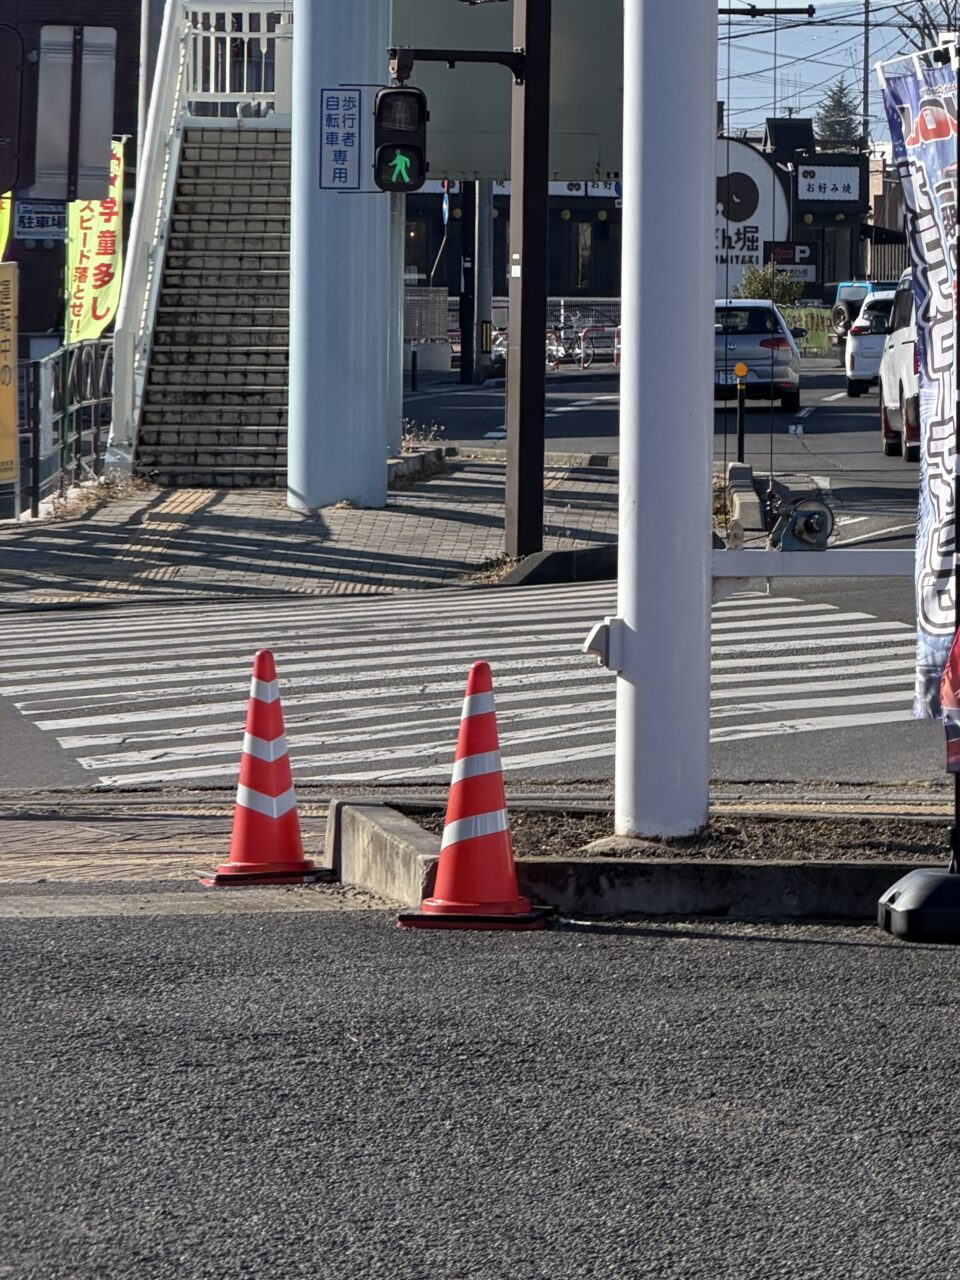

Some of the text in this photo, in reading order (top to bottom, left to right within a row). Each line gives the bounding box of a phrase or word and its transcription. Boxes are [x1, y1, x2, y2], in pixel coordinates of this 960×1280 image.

[325, 96, 340, 148] 自転車
[342, 96, 357, 148] 歩行者
[331, 150, 348, 183] 専用
[806, 183, 852, 194] お好み焼
[715, 226, 759, 251] ん堀
[716, 255, 759, 265] MIYAKI
[795, 245, 810, 263] P
